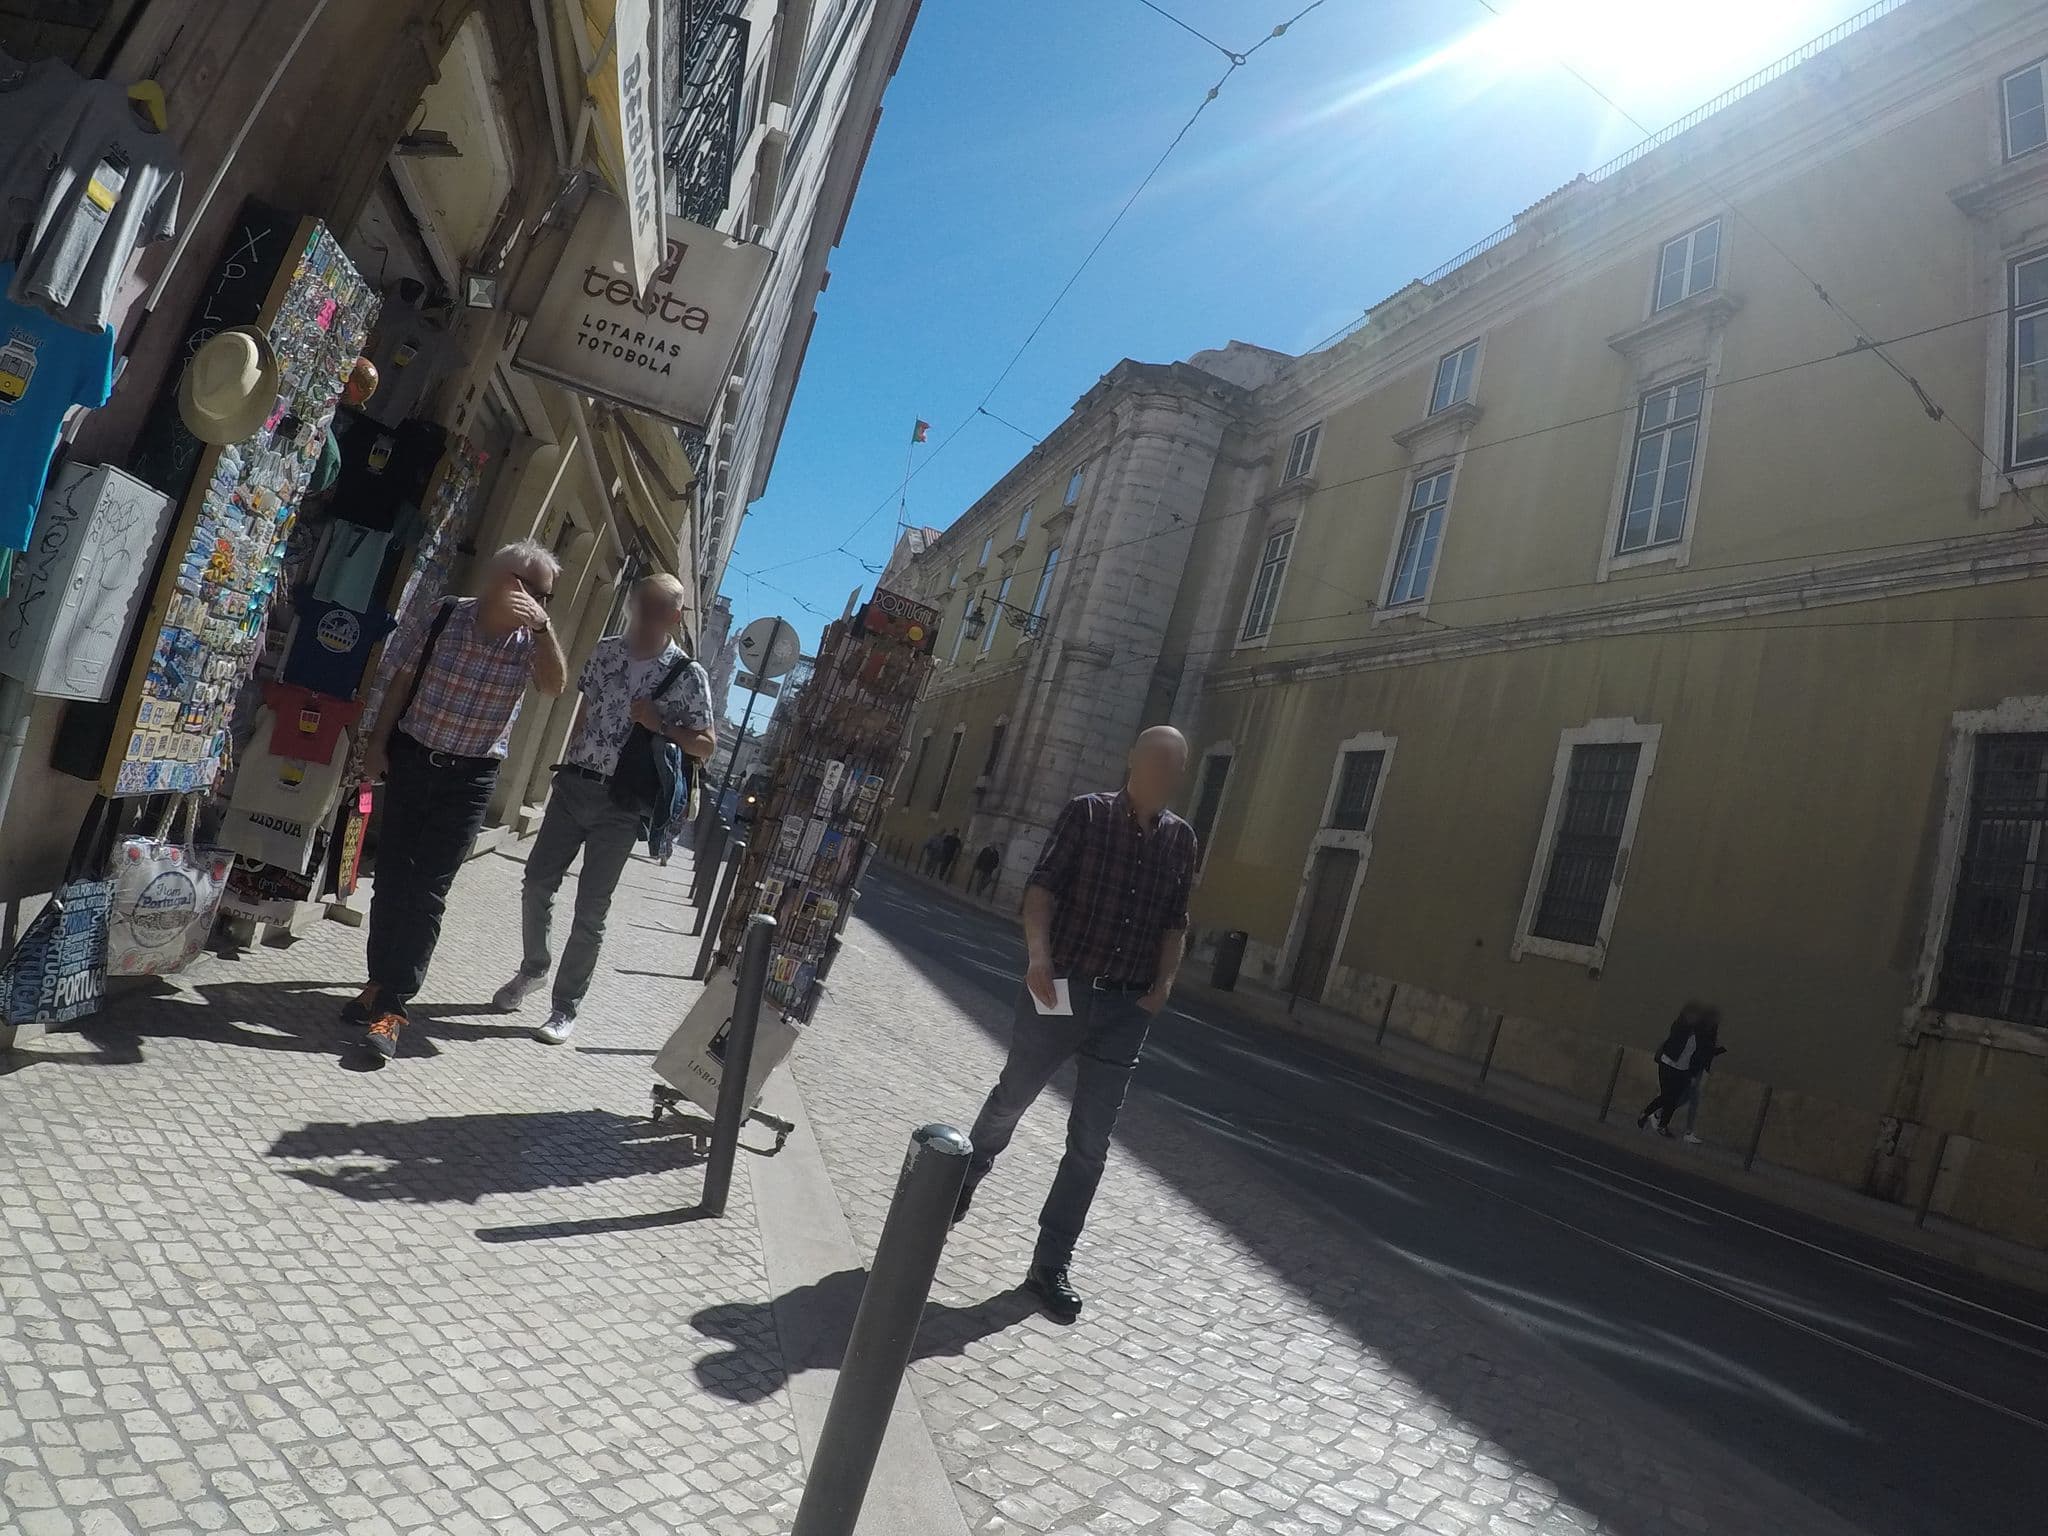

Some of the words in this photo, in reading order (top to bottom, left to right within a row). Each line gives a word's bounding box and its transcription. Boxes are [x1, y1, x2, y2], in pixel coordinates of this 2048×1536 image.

[623, 52, 650, 237] BEBIDAS
[583, 265, 709, 335] testa
[576, 332, 672, 376] TOTOBOLA
[582, 314, 681, 358] LOTARIAS
[687, 1060, 721, 1091] LISBO
